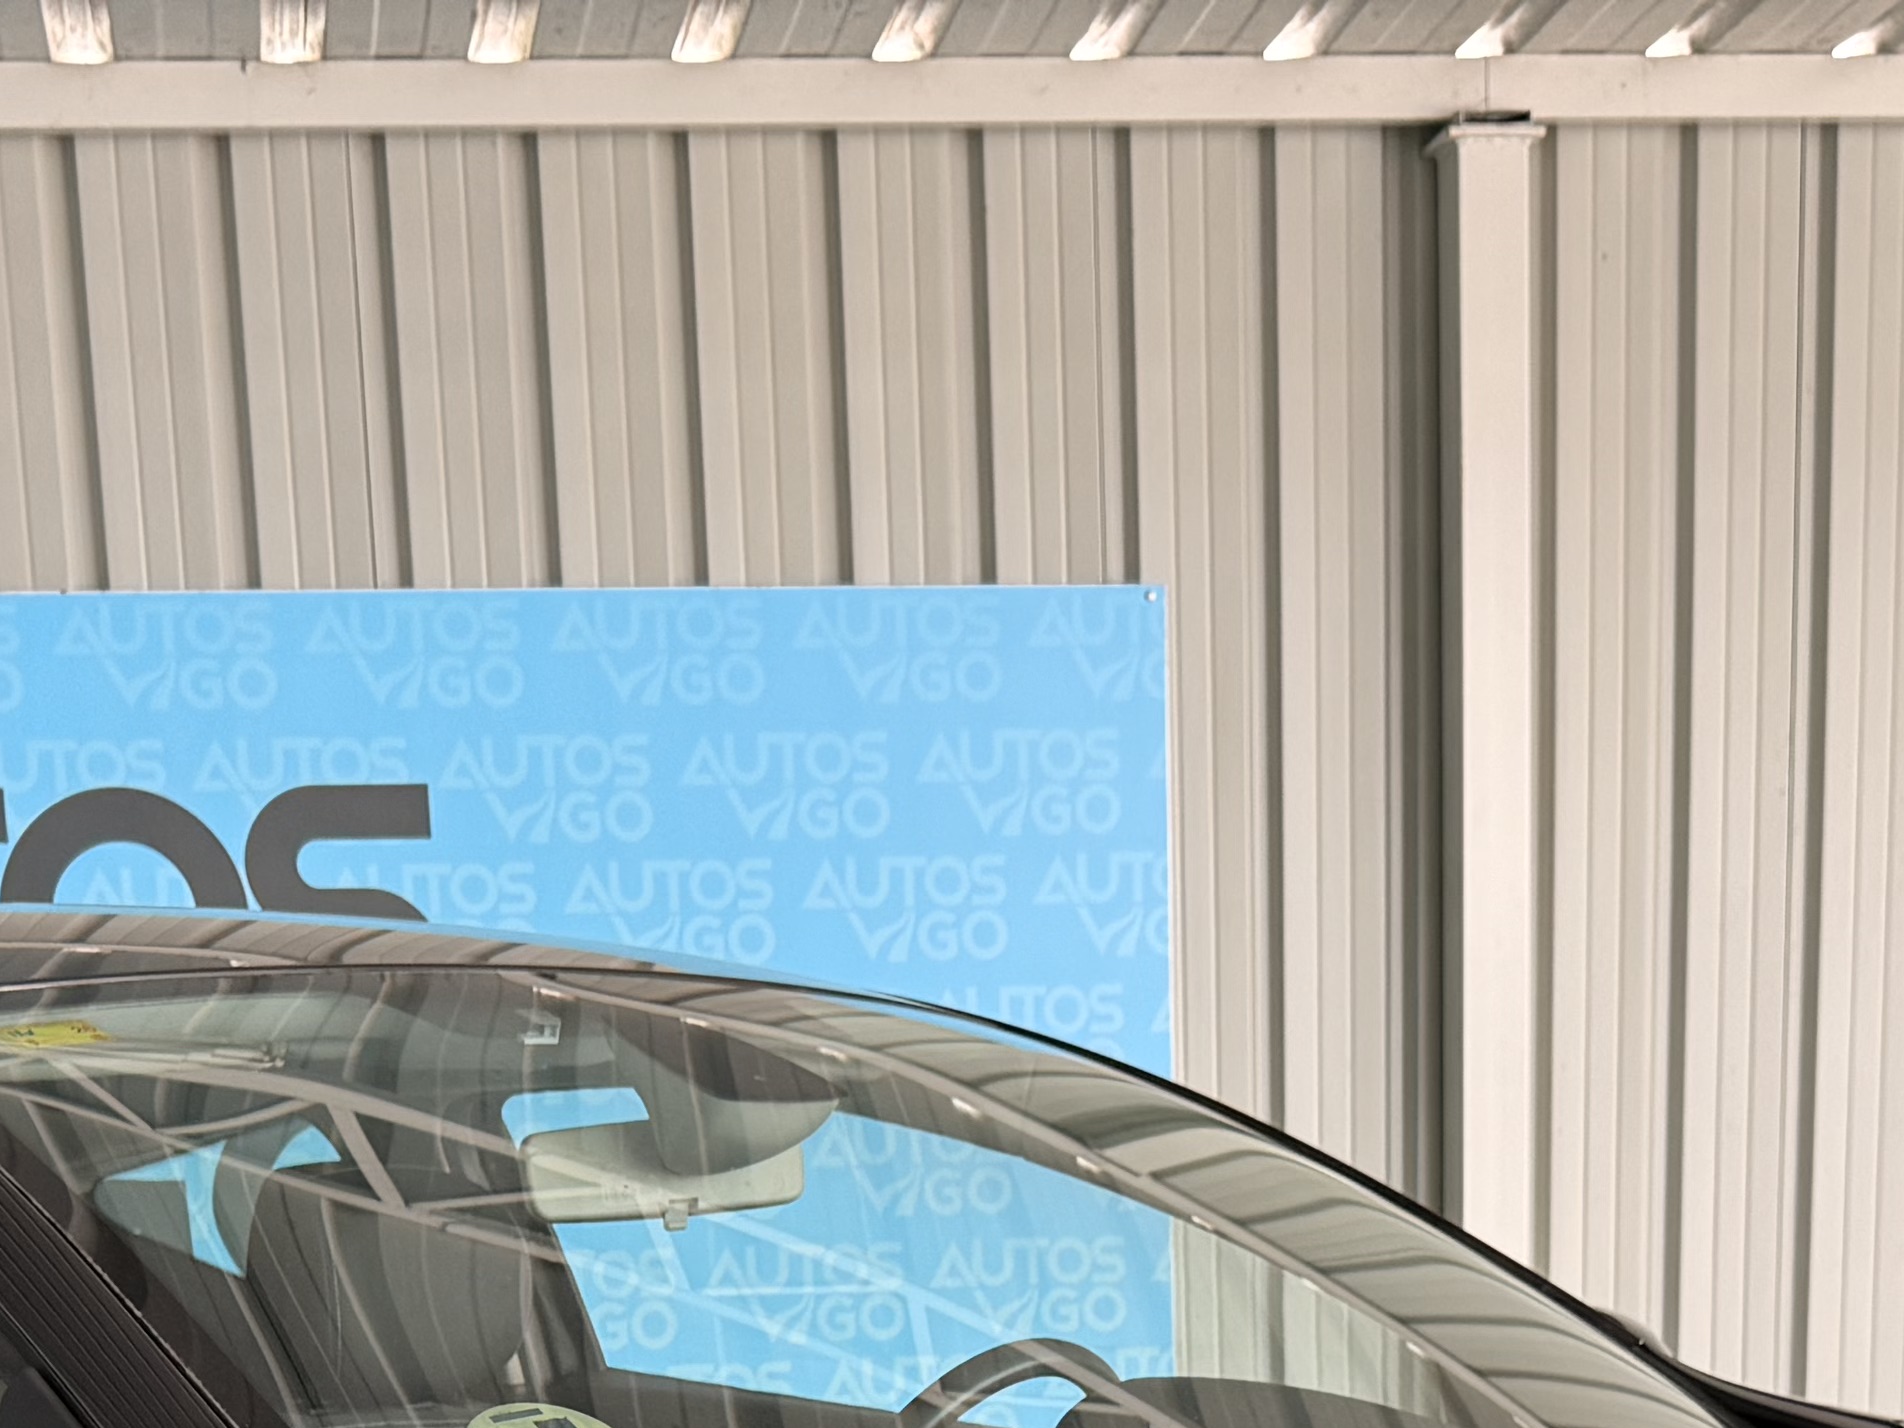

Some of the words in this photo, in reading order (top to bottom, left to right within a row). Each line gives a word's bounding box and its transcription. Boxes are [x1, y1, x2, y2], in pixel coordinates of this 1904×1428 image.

[53, 602, 275, 656] AUTOS
[304, 600, 521, 654] AUTOS
[550, 598, 764, 652] AUTOS
[792, 597, 1001, 649] AUTOS
[1027, 596, 1165, 647] AUT
[437, 733, 651, 788] AUTOS
[679, 731, 891, 786] AUTOS
[916, 727, 1121, 782] AUTOS
[564, 857, 773, 914] AUTOS
[802, 854, 1007, 909] AUTOS
[1032, 850, 1167, 905] AUT
[929, 1235, 1127, 1289] AUTOS
